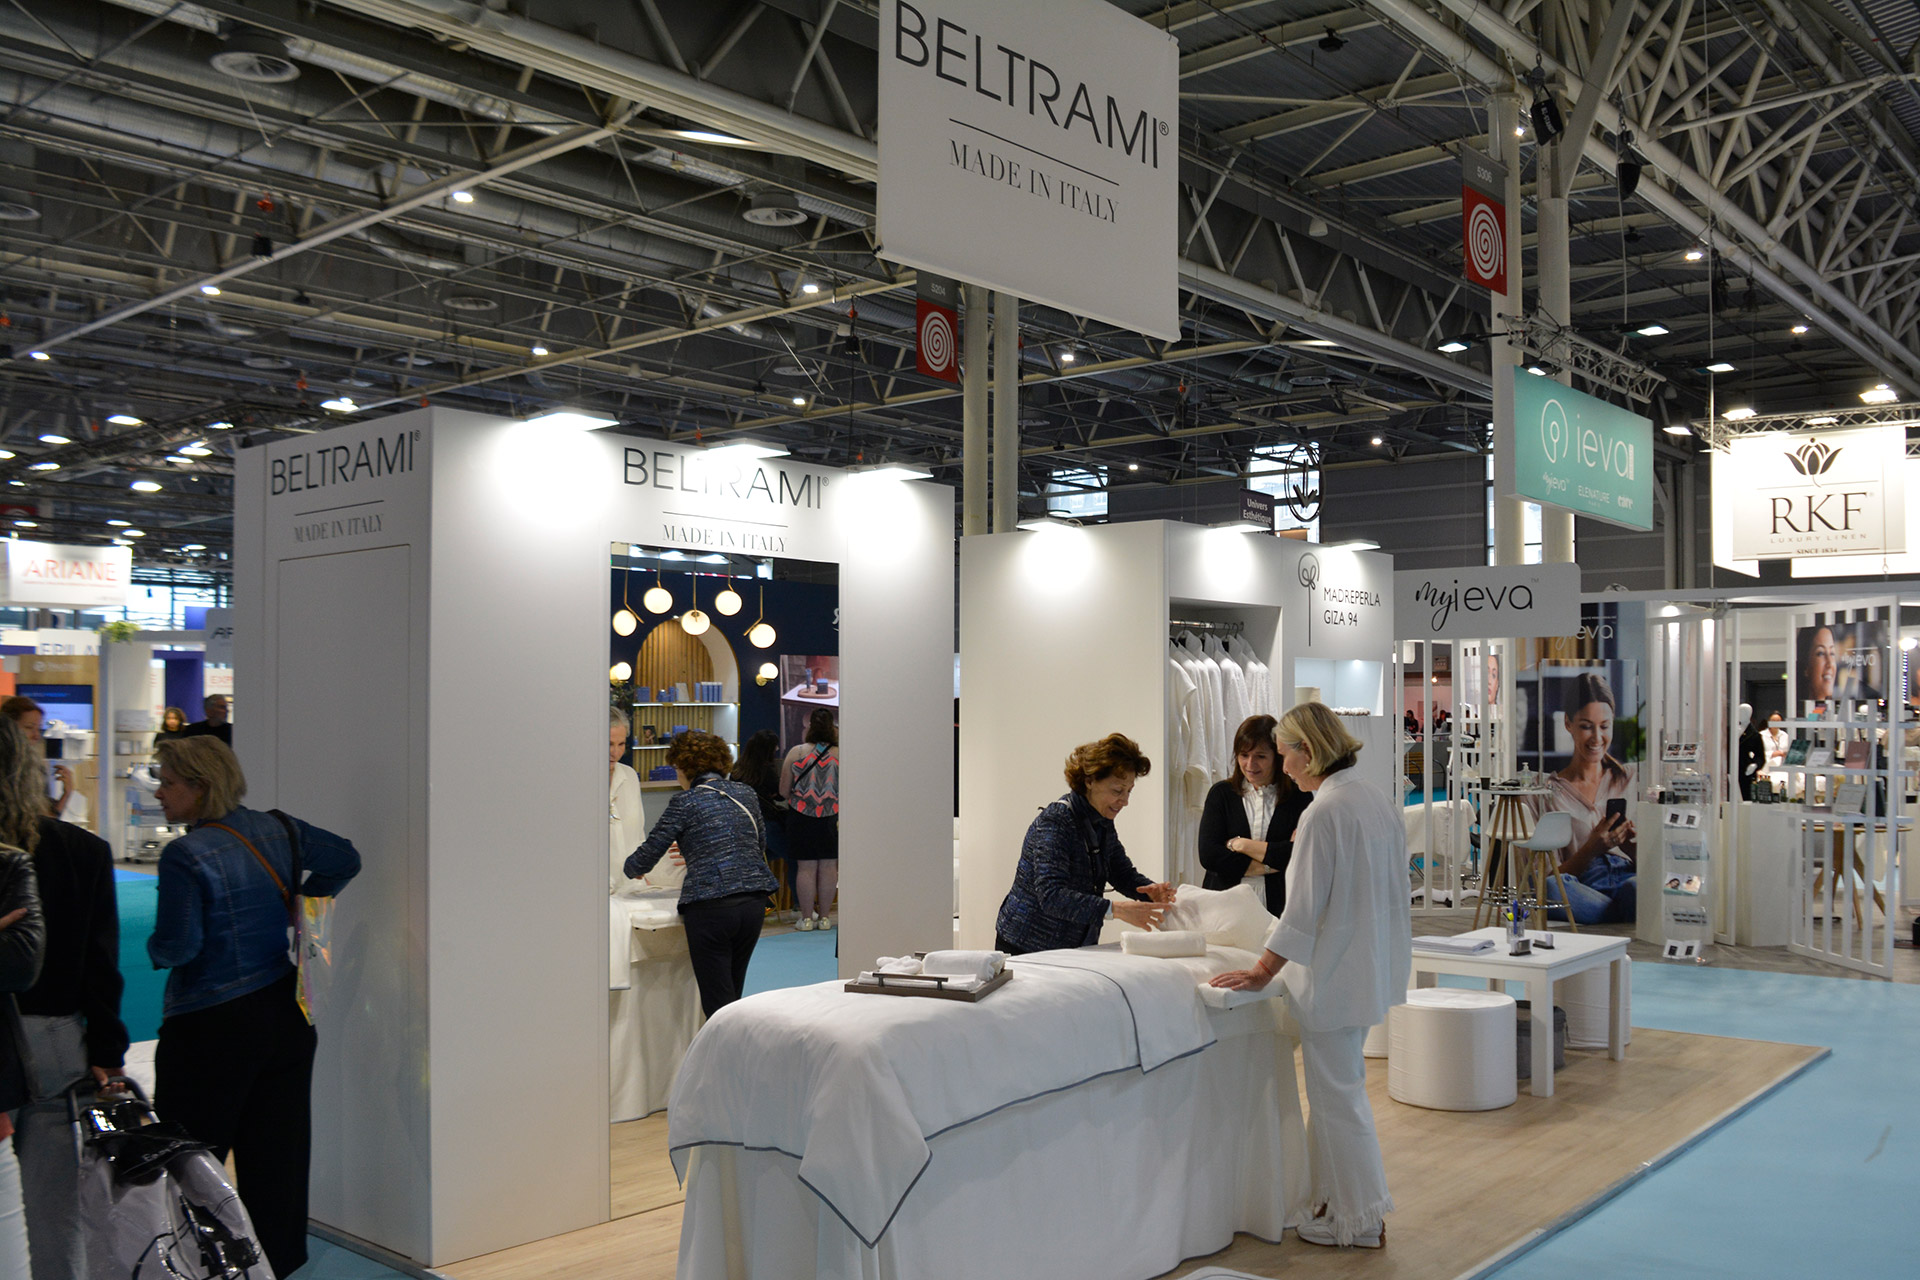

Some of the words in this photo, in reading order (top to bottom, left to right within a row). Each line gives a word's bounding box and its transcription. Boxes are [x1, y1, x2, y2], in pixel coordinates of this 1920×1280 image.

[949, 139, 1021, 189] MADE
[1028, 168, 1051, 200] IN
[1059, 180, 1119, 224] ITALY
[1246, 498, 1268, 511] Univers
[1242, 509, 1272, 524] Esthétique
[294, 522, 329, 543] MADE
[331, 519, 345, 539] IN
[347, 513, 384, 536] ITALY
[663, 524, 714, 546] MADE
[720, 531, 735, 547] IN
[742, 533, 788, 553] ITALY
[1770, 536, 1820, 544] LUXURY
[1827, 533, 1868, 541] LINEN
[23, 559, 118, 581] ARIANE
[1323, 586, 1381, 607] MADREPERLA
[1323, 609, 1346, 625] GIZA
[1348, 612, 1358, 626] 94
